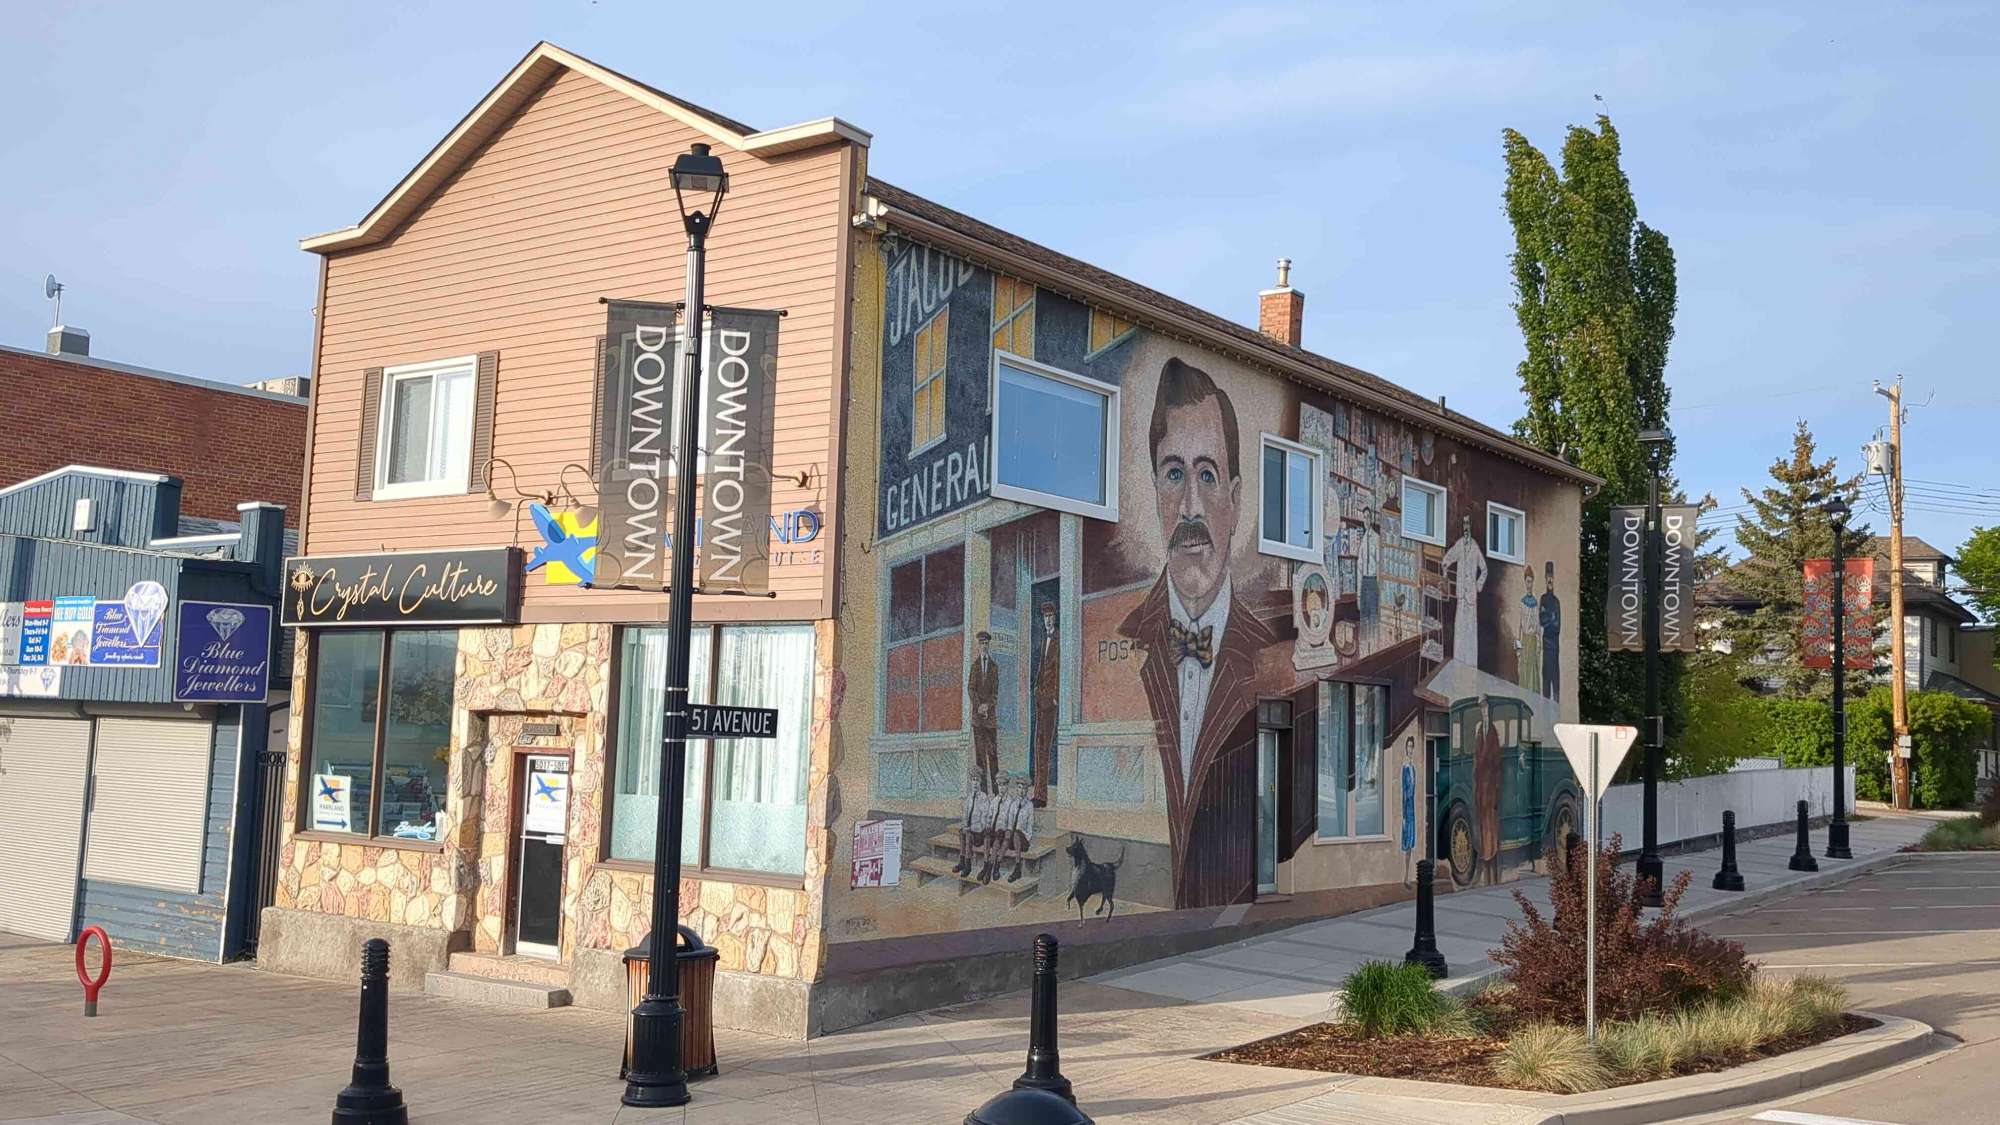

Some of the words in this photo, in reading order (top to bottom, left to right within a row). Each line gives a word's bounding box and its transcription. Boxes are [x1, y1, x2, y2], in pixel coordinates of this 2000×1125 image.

[622, 324, 667, 580] DOWNTOWN
[708, 329, 751, 583] DOWNTOWN
[311, 563, 395, 621] Crystal
[399, 560, 498, 614] Culture
[1621, 517, 1640, 646] DOWNTOWN
[1663, 515, 1683, 646] DOWNTOWN
[183, 656, 266, 676] Diamond
[201, 641, 245, 659] Blue
[178, 674, 256, 697] Jewellers
[691, 708, 709, 732] 51
[712, 709, 772, 734] AVENUE
